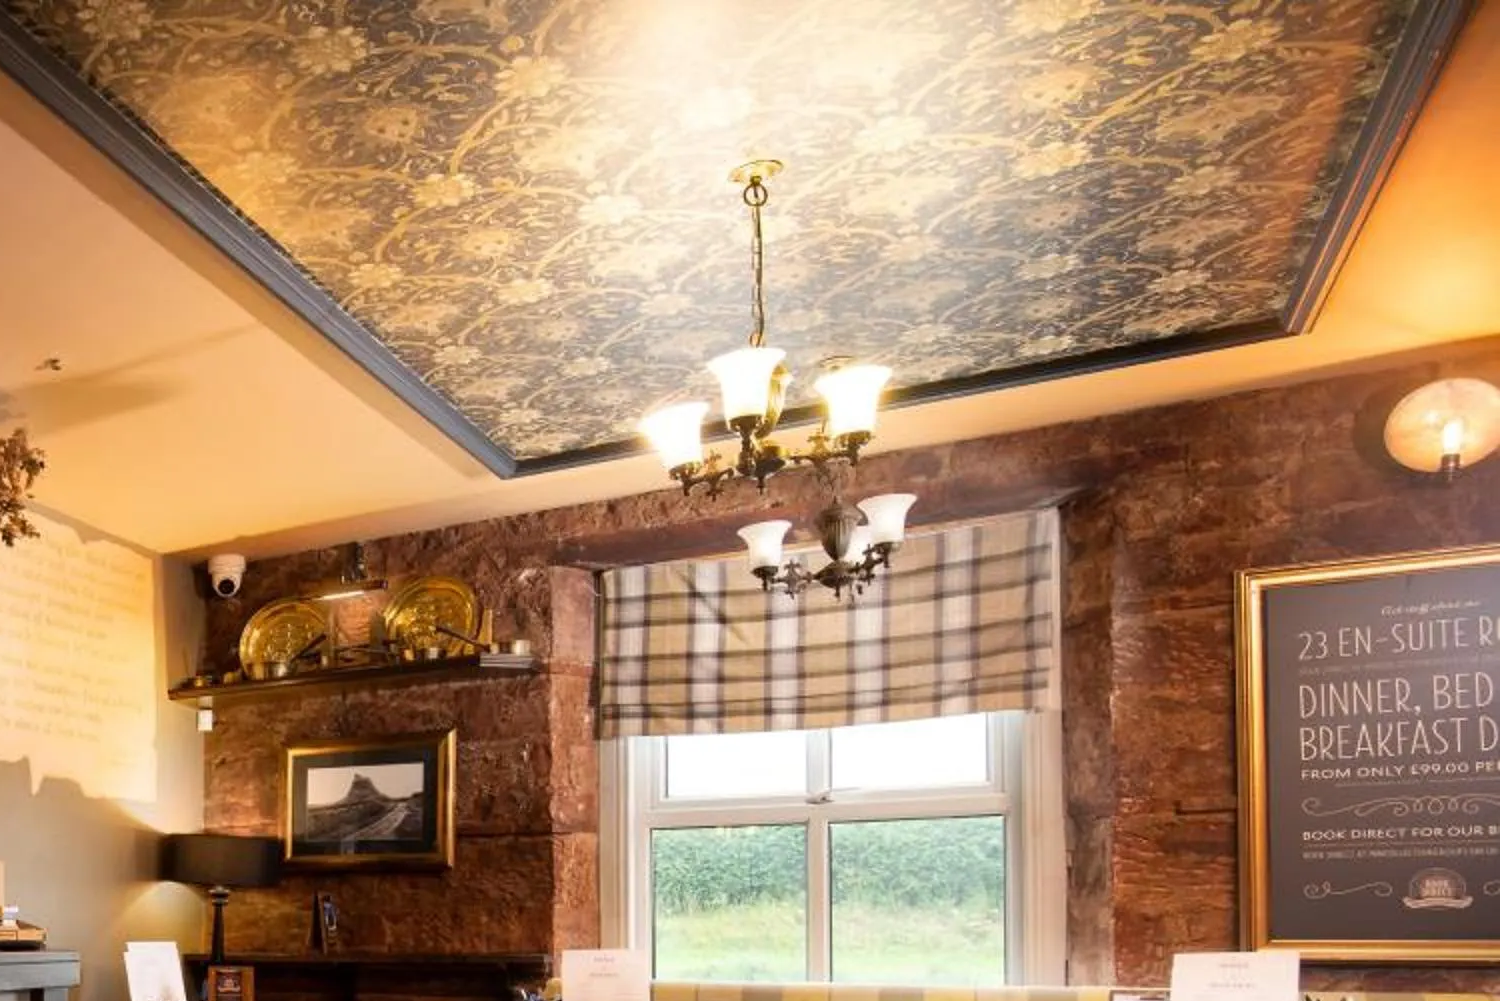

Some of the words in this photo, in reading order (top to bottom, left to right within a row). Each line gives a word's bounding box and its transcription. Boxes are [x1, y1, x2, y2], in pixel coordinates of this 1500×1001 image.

[1298, 630, 1329, 661] 23
[1338, 617, 1471, 658] EN-SUITE
[1478, 615, 1500, 647] R
[1299, 676, 1422, 719] DINNER,
[1432, 671, 1494, 711] BED
[1299, 717, 1469, 761] BREAKFAST
[1478, 714, 1499, 751] D
[1301, 767, 1351, 781] FROM
[1356, 764, 1405, 778] ONLY
[1411, 762, 1470, 775] £99.00
[1302, 829, 1347, 841] BOOK
[1351, 827, 1406, 839] DIRECT
[1411, 826, 1443, 838] FOR
[1447, 825, 1484, 837] OUR
